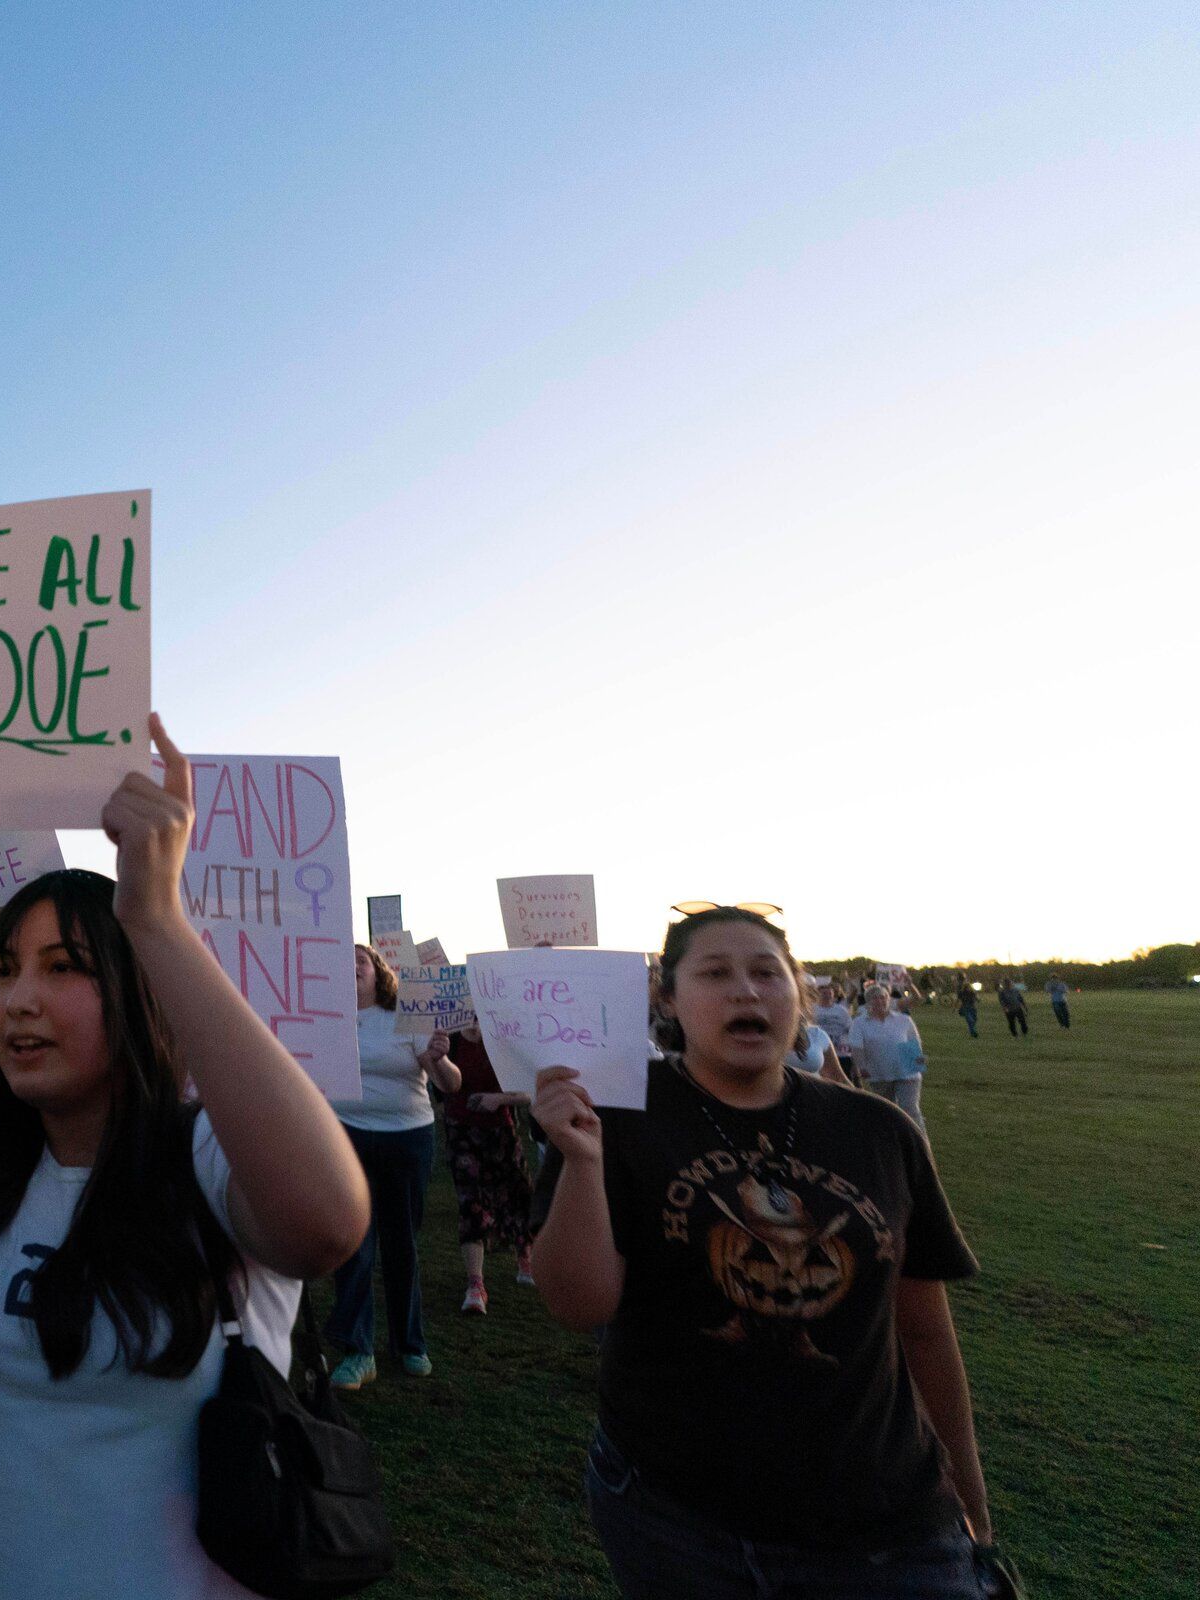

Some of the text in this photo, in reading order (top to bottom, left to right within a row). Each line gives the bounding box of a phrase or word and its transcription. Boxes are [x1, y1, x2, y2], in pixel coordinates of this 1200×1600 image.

[152, 760, 336, 859] TAND
[182, 864, 282, 928] WITH
[400, 966, 433, 980] REAL
[473, 966, 575, 1005] We are
[536, 1002, 609, 1049] Doe!
